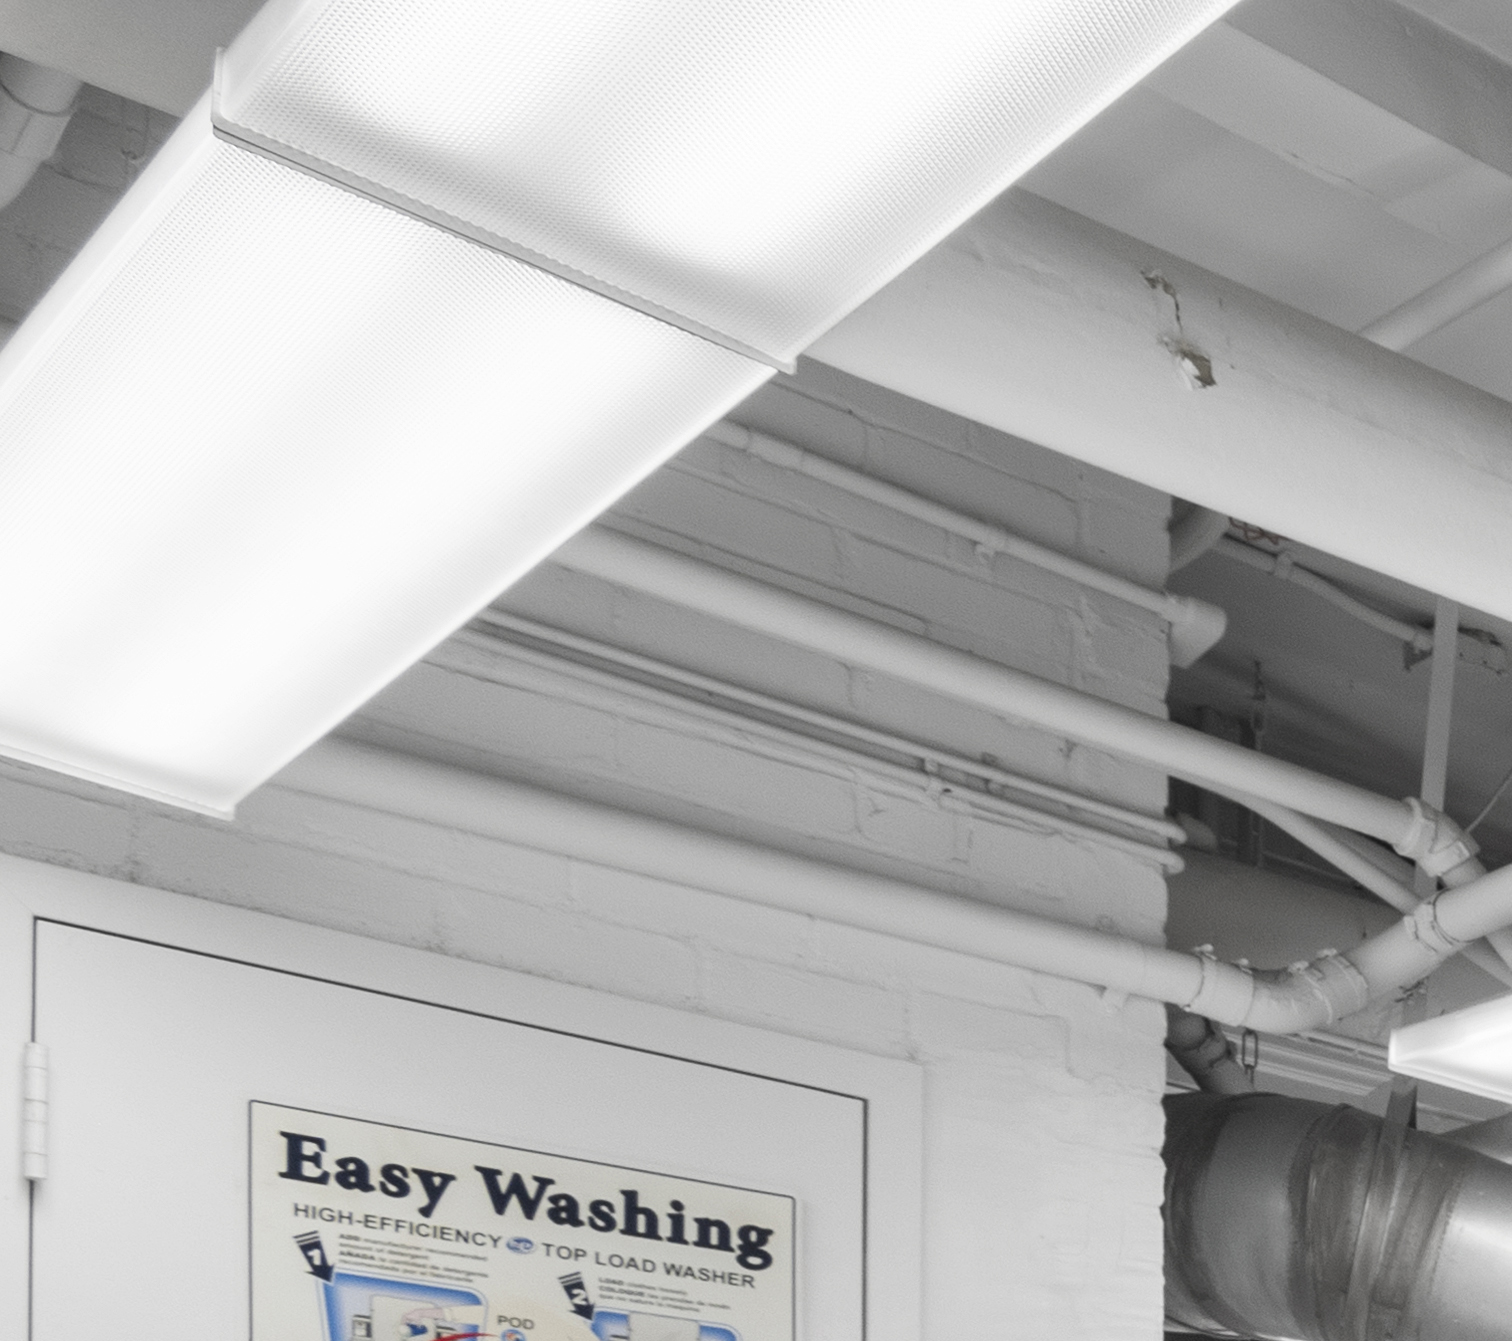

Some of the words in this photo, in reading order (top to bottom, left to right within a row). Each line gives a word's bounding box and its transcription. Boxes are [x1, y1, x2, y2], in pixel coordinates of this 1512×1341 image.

[278, 1130, 457, 1218] Easy
[473, 1165, 774, 1270] Washing
[294, 1203, 503, 1249] HIGH-EFFICIENCY
[542, 1242, 587, 1261] TOP
[594, 1252, 657, 1273] LOAD
[663, 1262, 755, 1289] WASHER
[305, 1248, 322, 1266] 1
[496, 1314, 535, 1330] POD
